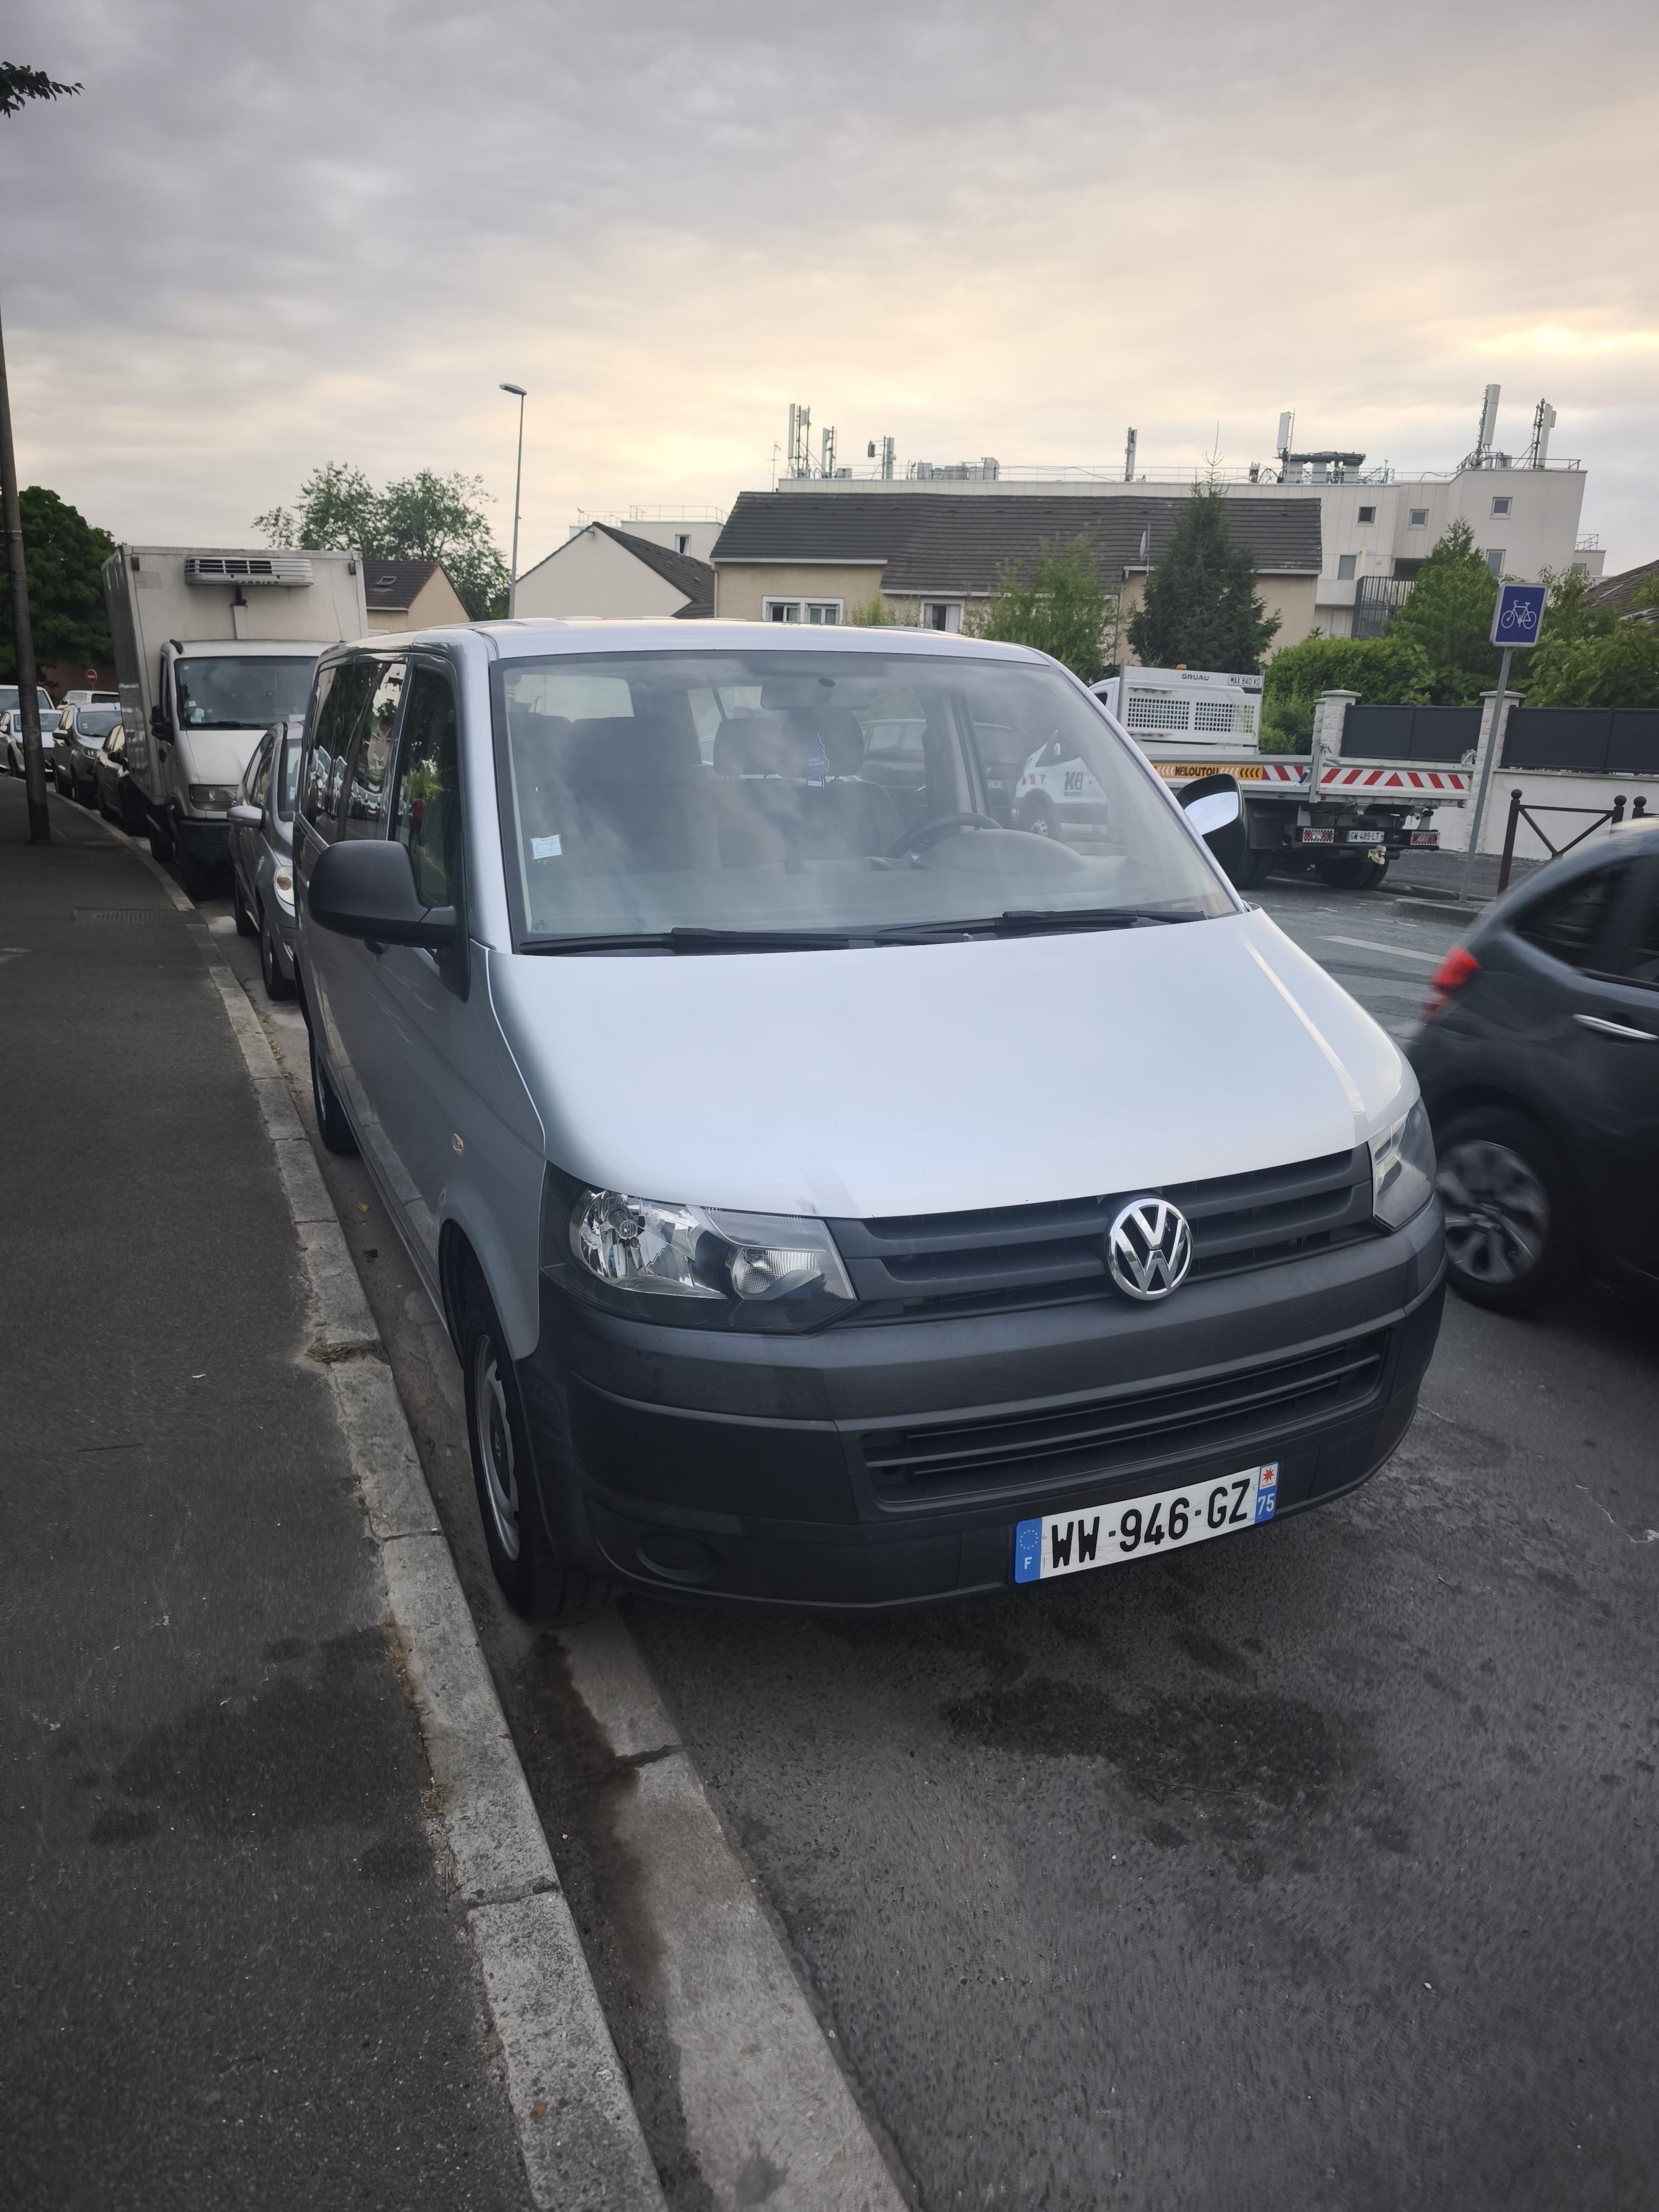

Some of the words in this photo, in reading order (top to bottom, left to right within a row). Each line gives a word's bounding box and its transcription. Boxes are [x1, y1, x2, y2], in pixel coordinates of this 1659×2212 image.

[1257, 1492, 1275, 1515] 75
[1051, 1478, 1251, 1568] WW-946-GZ
[1024, 1556, 1032, 1570] F
